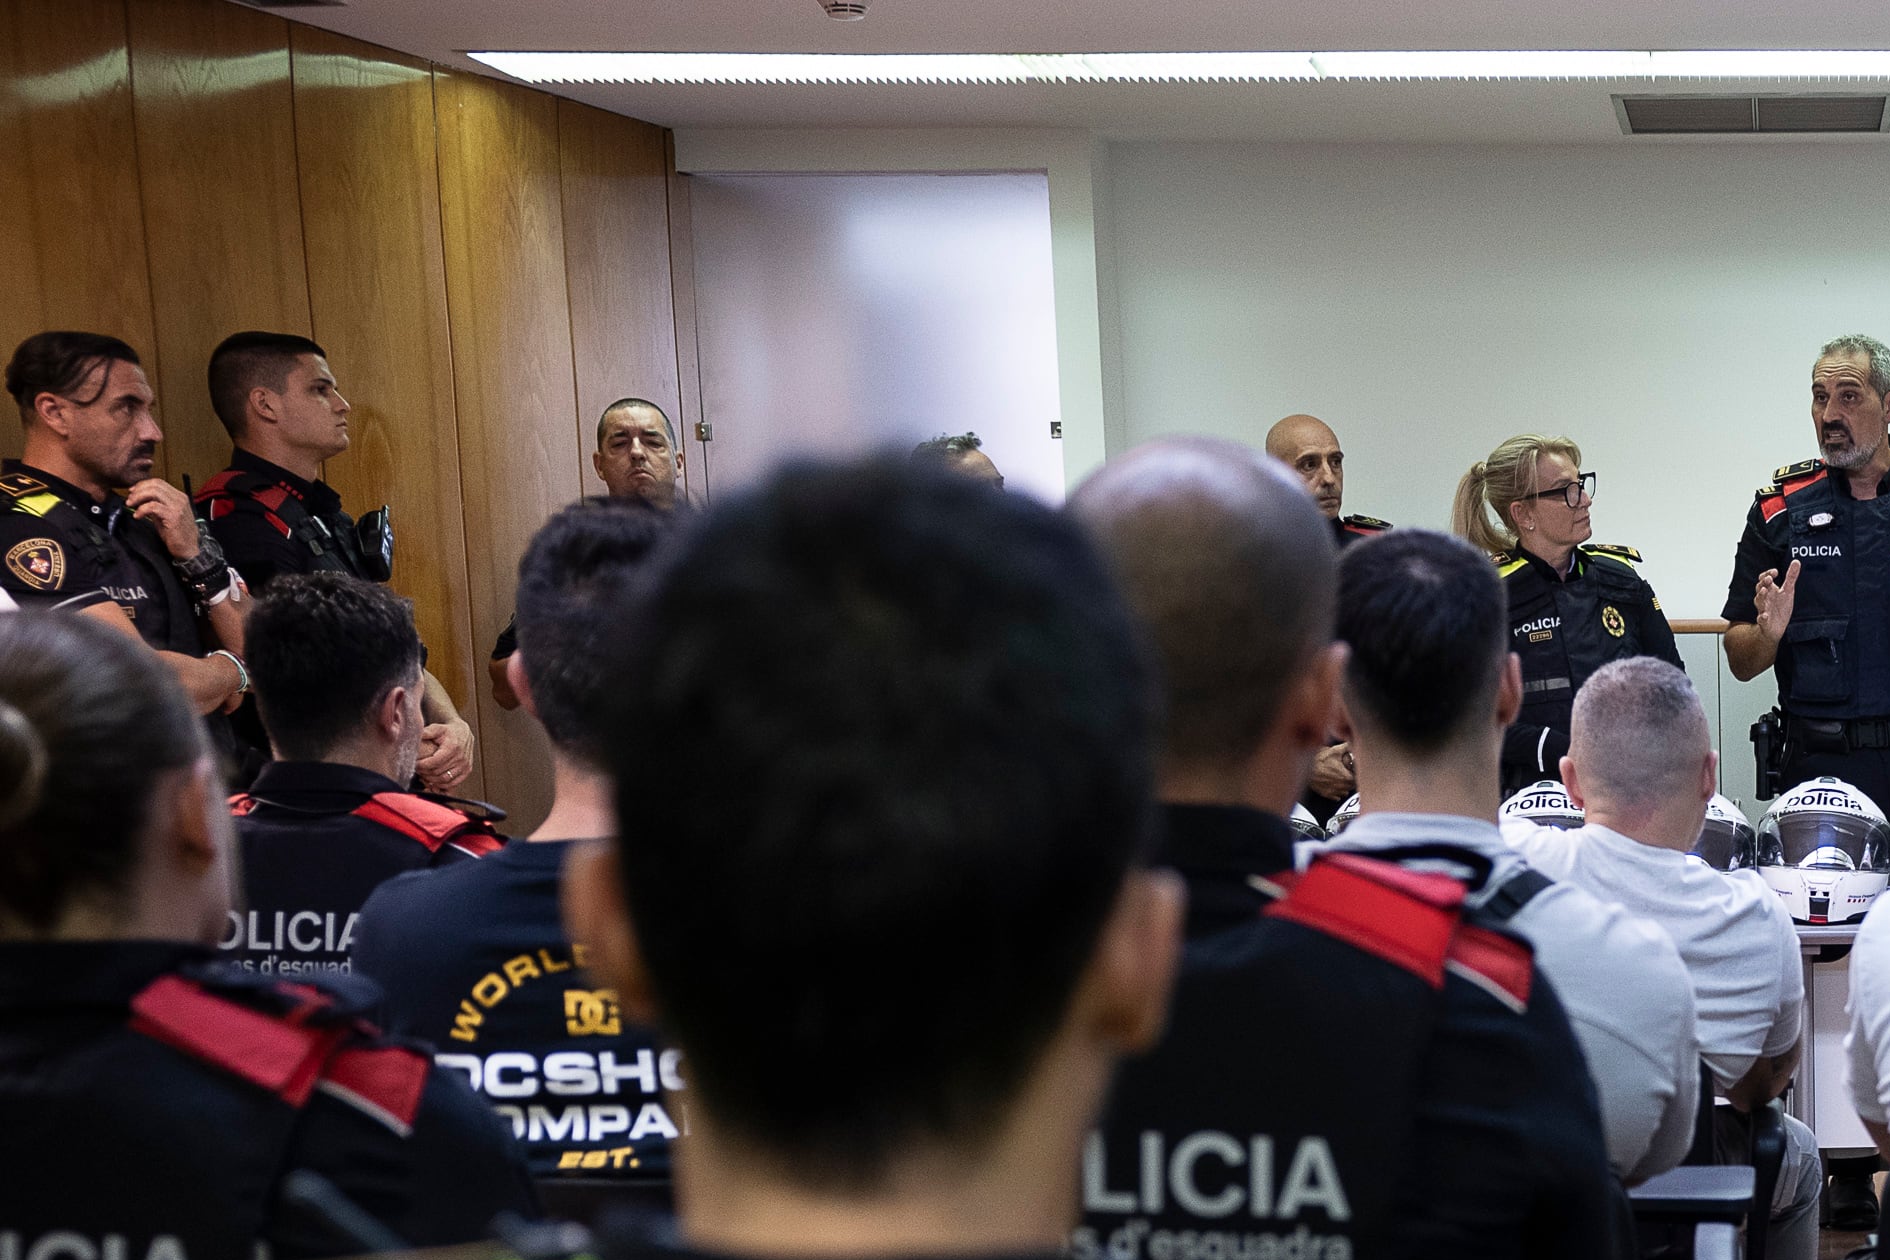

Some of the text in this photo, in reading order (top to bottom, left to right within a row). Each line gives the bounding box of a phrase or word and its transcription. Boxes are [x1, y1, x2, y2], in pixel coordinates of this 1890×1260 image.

[1791, 545, 1842, 558] POLICIA
[1786, 792, 1863, 812] policia
[217, 910, 362, 953] OLICIA
[556, 1147, 641, 1169] EST.
[1081, 1128, 1352, 1222] LICIA
